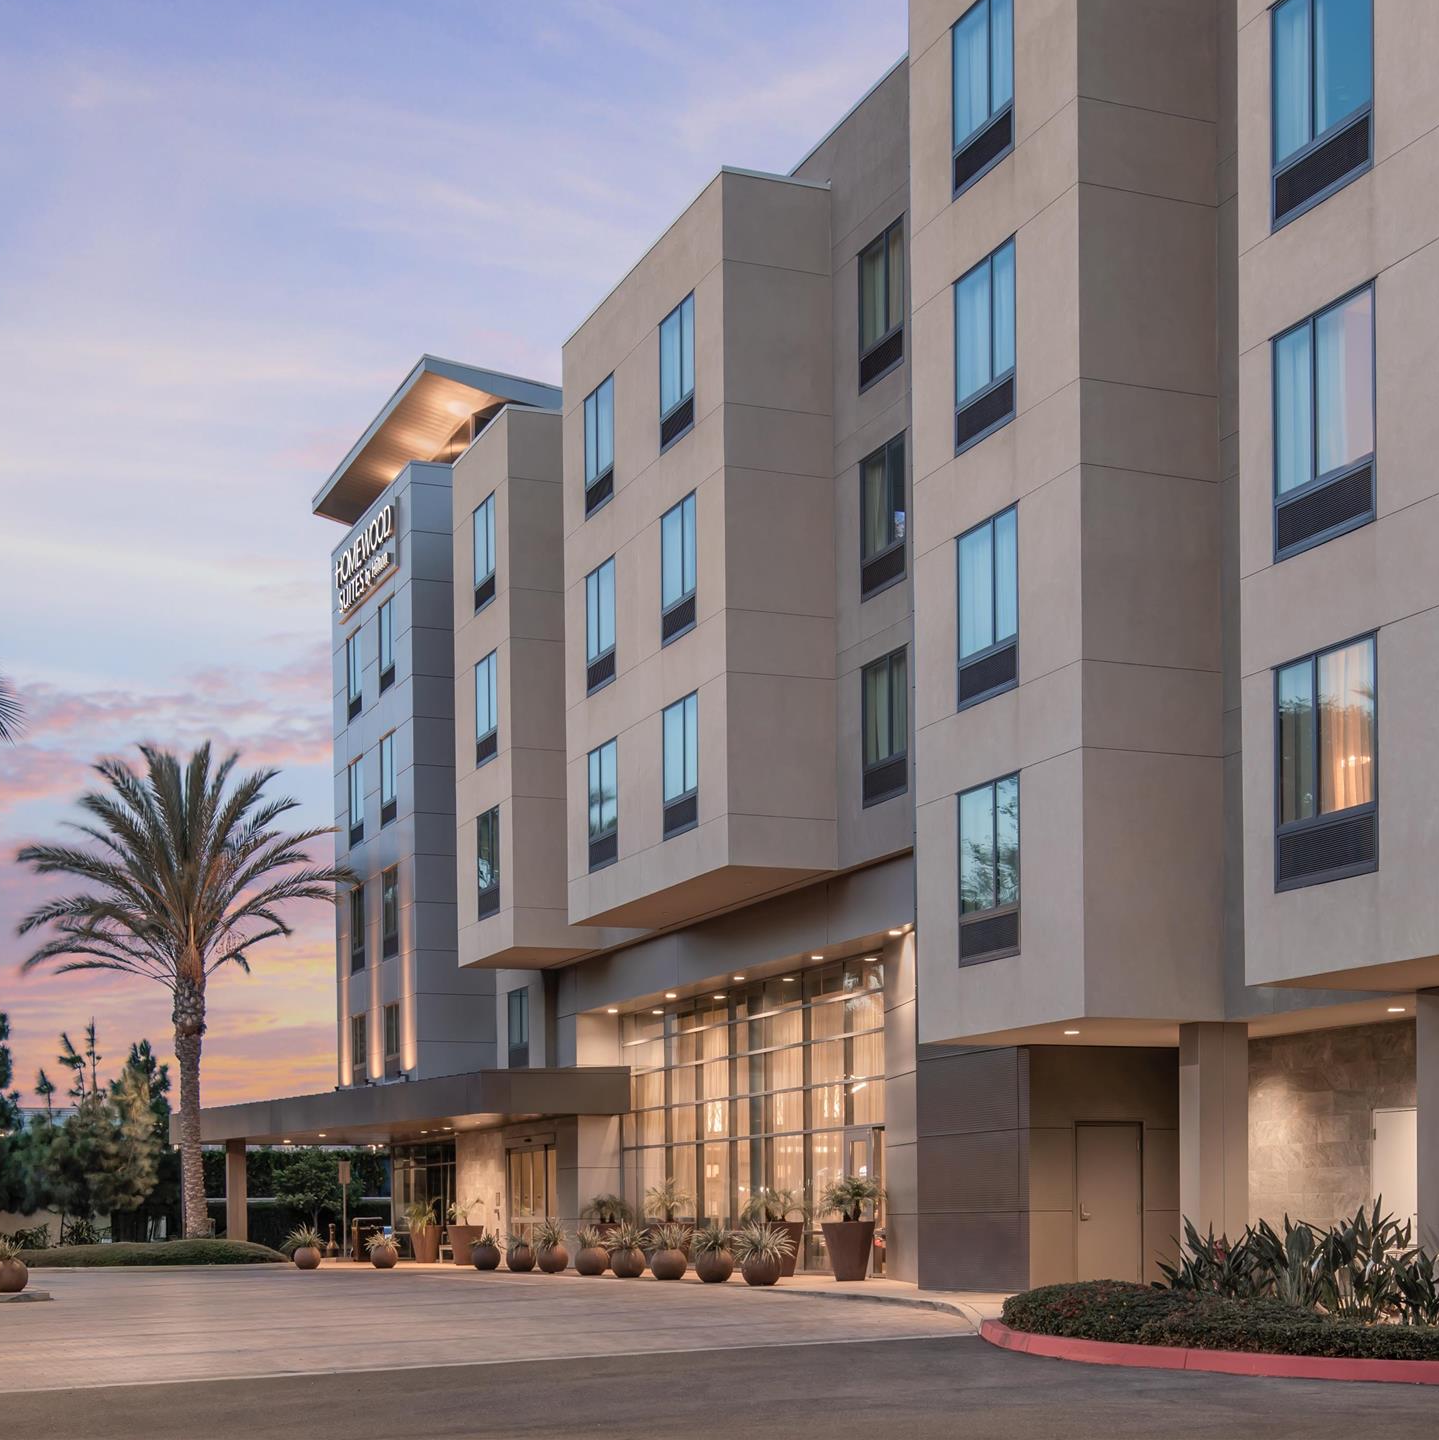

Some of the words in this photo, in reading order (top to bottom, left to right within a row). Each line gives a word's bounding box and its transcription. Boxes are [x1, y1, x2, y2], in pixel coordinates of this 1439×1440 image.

[335, 505, 391, 589] HOMEWOOD
[339, 569, 364, 614] SUITES
[371, 552, 388, 578] Hilton
